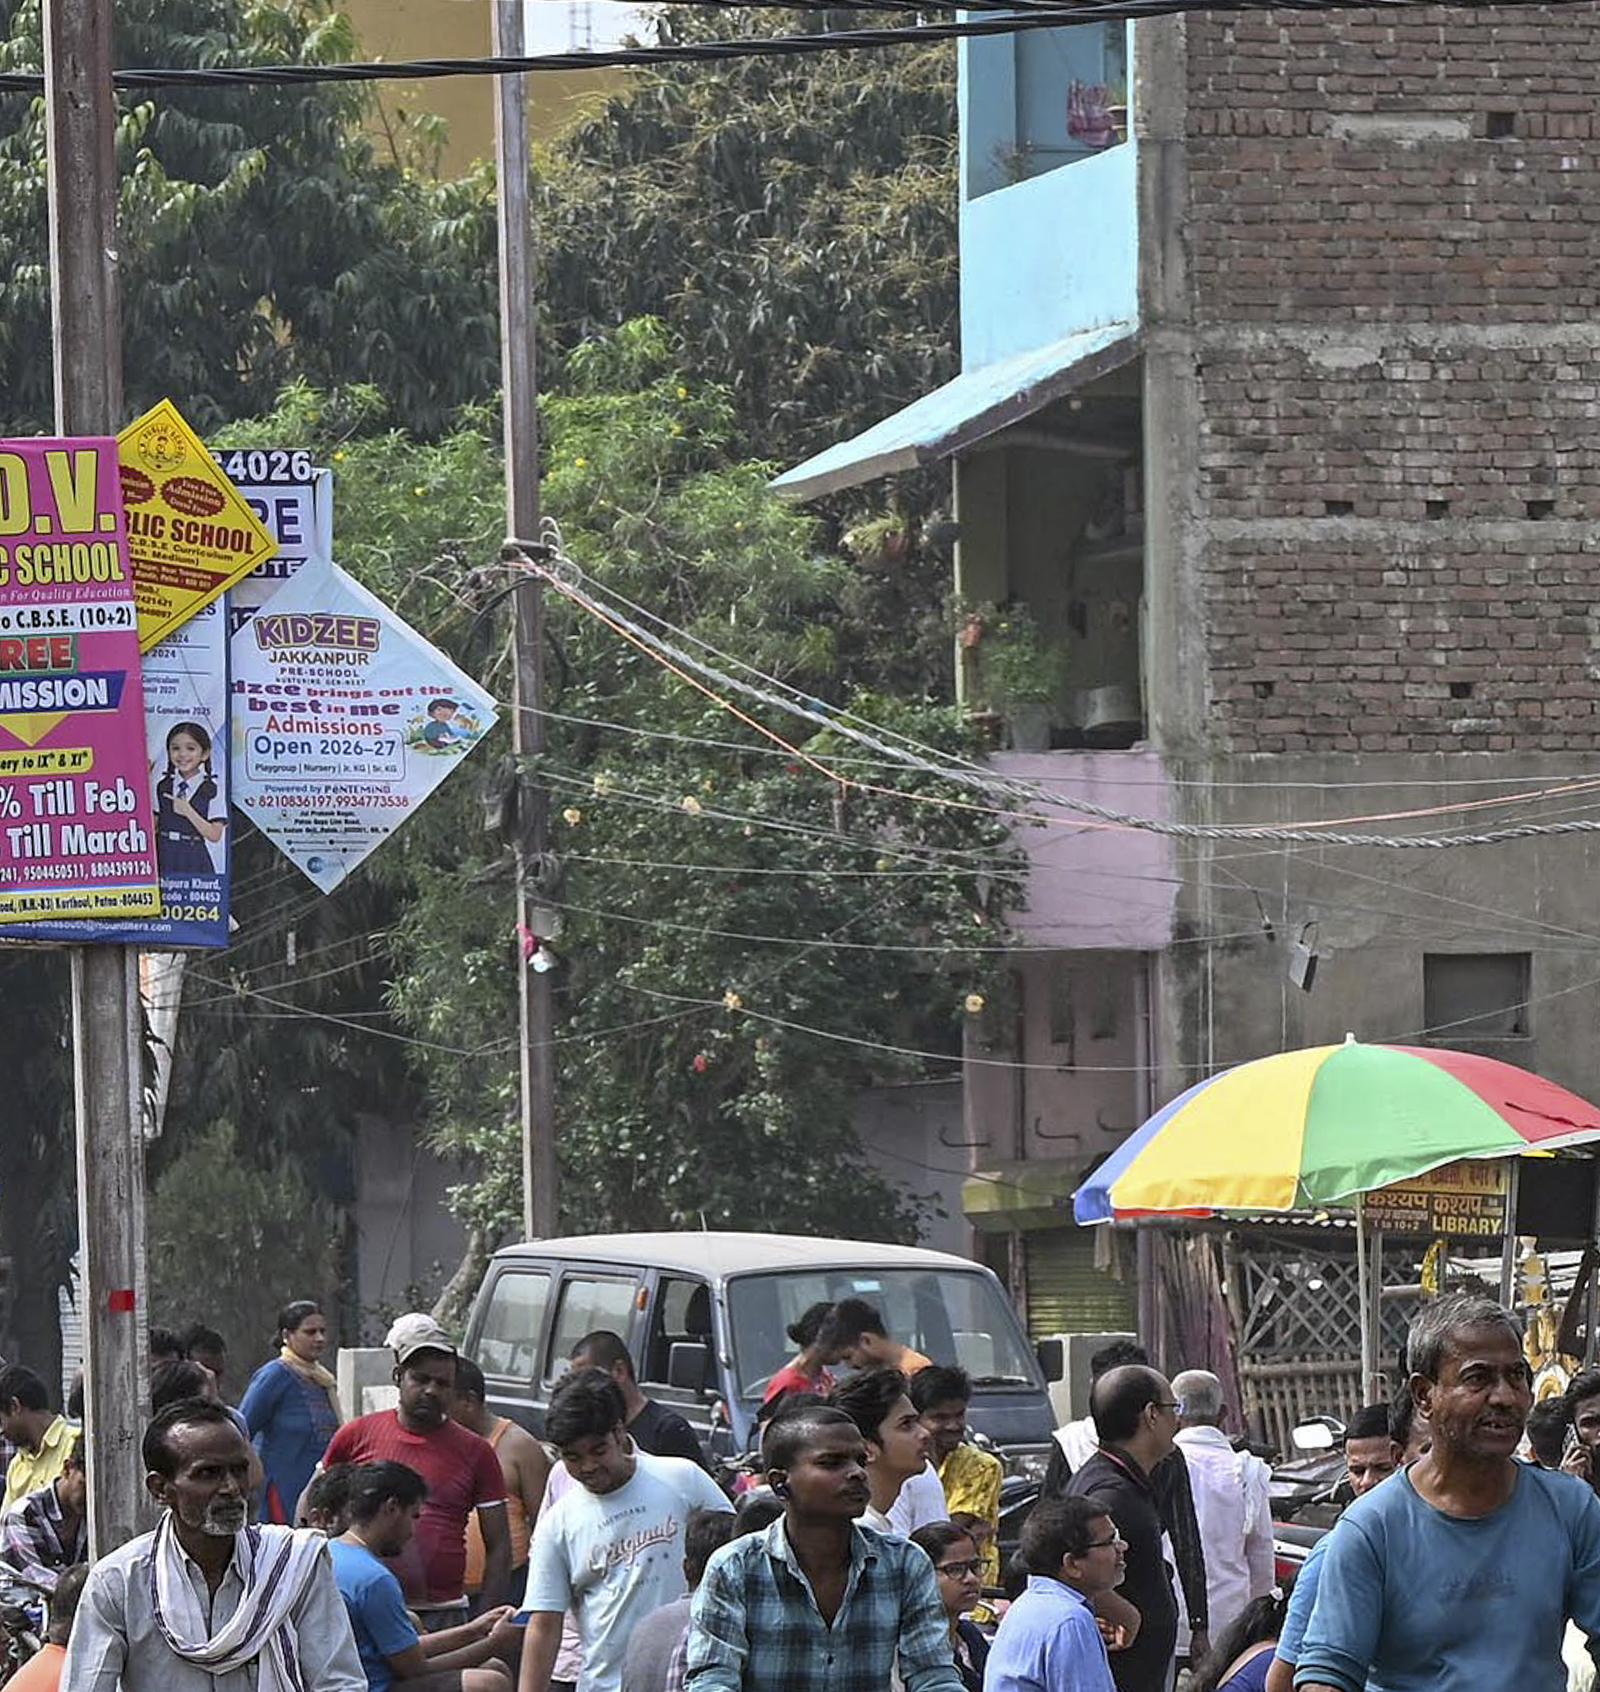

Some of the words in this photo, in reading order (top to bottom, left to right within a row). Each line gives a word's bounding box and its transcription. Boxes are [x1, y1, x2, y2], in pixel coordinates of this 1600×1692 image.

[170, 517, 255, 555] SCHOOL
[15, 541, 125, 586] SCHOOL
[31, 587, 73, 602] Quality
[75, 586, 131, 600] Education
[16, 608, 75, 629] C.B.S.E.
[79, 606, 132, 628] (10+2)
[253, 614, 380, 652] KIDZEE
[268, 650, 370, 667] JAKKANPUR
[279, 666, 360, 678] PRE-SCHOOL
[306, 687, 375, 700] brings
[378, 686, 414, 698] out
[418, 685, 456, 697] the
[248, 697, 324, 715] best
[326, 702, 346, 714] in
[349, 702, 402, 716] me
[265, 714, 384, 736] Admissions
[254, 735, 313, 760] Open
[255, 763, 298, 775] Playgroup
[303, 762, 338, 775] Nursery
[29, 779, 76, 817] Till
[84, 777, 136, 815] Feb
[264, 784, 309, 794] Powered
[309, 785, 322, 797] by
[6, 823, 52, 860] Till
[61, 819, 148, 857] March
[1432, 1214, 1502, 1236] LIBRARY
